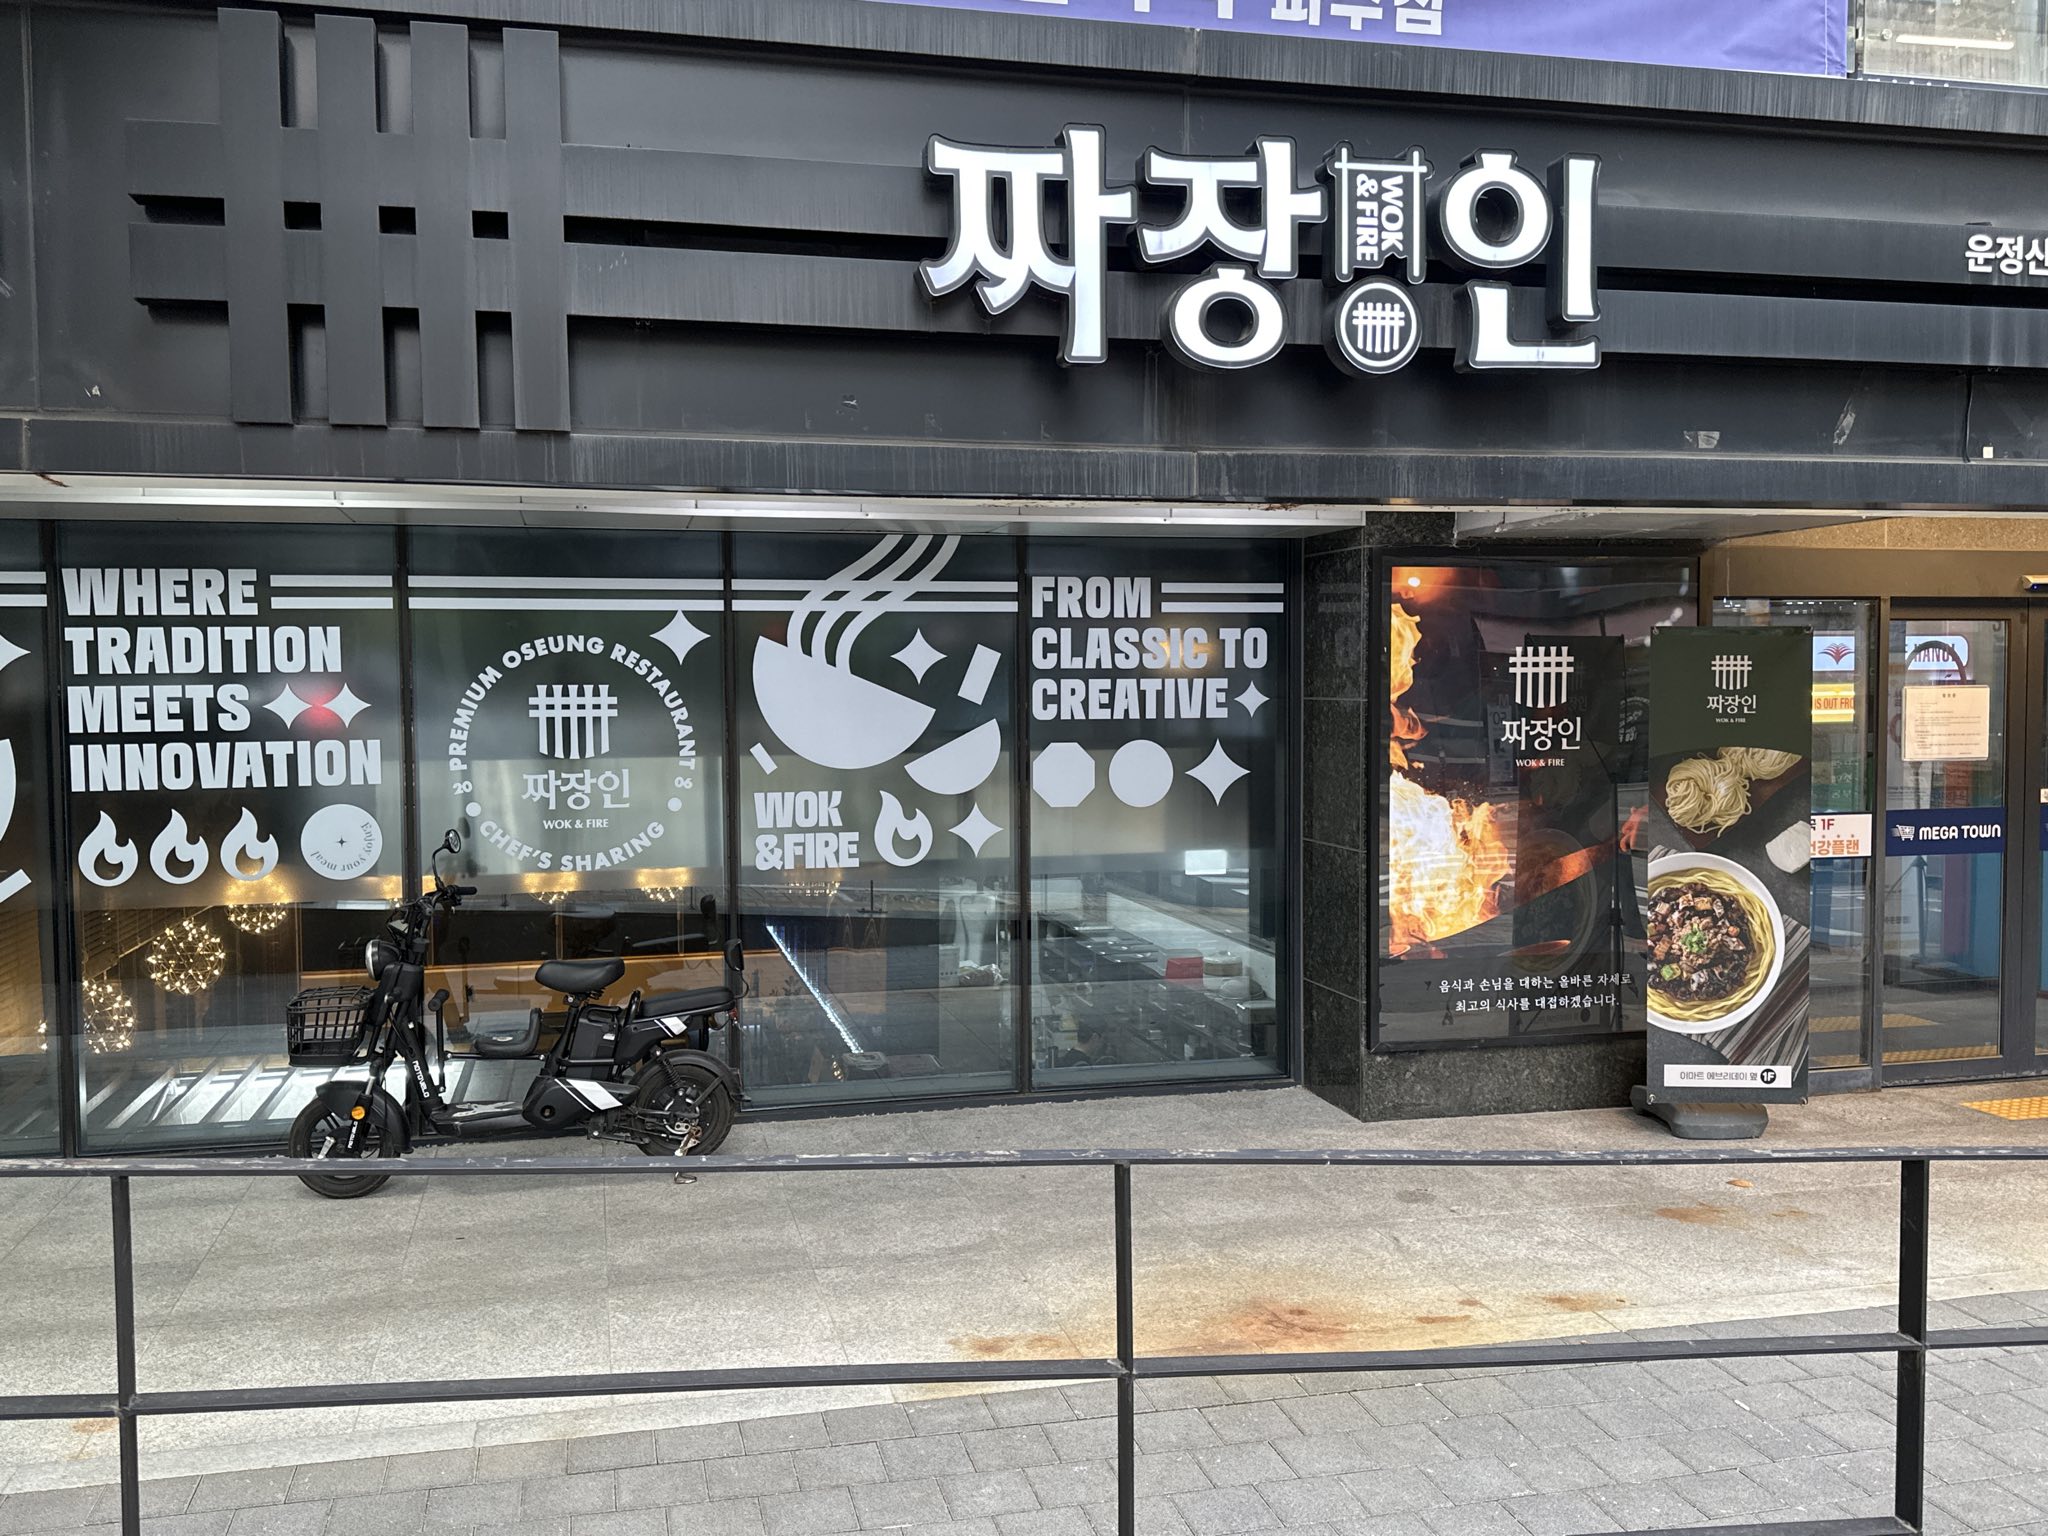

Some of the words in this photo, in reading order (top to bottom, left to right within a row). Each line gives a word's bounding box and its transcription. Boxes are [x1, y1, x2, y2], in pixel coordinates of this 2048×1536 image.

[1381, 175, 1404, 252] WOK
[62, 568, 258, 616] WHERE
[1031, 576, 1151, 618] FROM
[64, 626, 342, 675] TRADITION
[1031, 627, 1208, 670] CLASSIC
[1219, 627, 1268, 669] TO
[67, 683, 251, 733] MEETS
[449, 665, 503, 771] PREMIUM
[502, 635, 605, 669] OSEUNG
[610, 643, 696, 770] RESTAURANT
[1031, 677, 1229, 720] CREATIVE
[1706, 694, 1757, 714] 짜장인
[1823, 697, 1838, 709] OUT
[1500, 716, 1582, 751] 짜장인
[69, 739, 382, 792] INNOVATION
[1515, 758, 1537, 767] WOK
[1538, 758, 1546, 767] &
[1548, 758, 1565, 767] FIRE
[452, 780, 473, 796] 20
[521, 768, 630, 811] 짜장인
[543, 819, 573, 830] WOK
[574, 819, 583, 829] &
[586, 818, 609, 828] FIRE
[754, 790, 843, 828] WOK
[1821, 818, 1835, 830] 1F
[360, 821, 376, 855] Enjoy
[479, 820, 553, 870] CHEF'S
[560, 821, 665, 872] SHARING
[1919, 825, 1959, 840] MEGA
[1960, 824, 2001, 839] TOWN
[310, 850, 338, 871] meal
[341, 854, 366, 872] your
[1439, 979, 1475, 993] 음식과
[1479, 977, 1515, 992] 손님을
[1519, 975, 1554, 990] 대하는
[1558, 974, 1593, 988] 올바른
[1597, 972, 1632, 986] 자세로
[1455, 998, 1490, 1013] 최고의
[1495, 997, 1531, 1012] 식사를
[1534, 994, 1620, 1010] 대접하겠습니다.
[1680, 1071, 1704, 1080] 이마트
[1761, 1071, 1775, 1082] 1F
